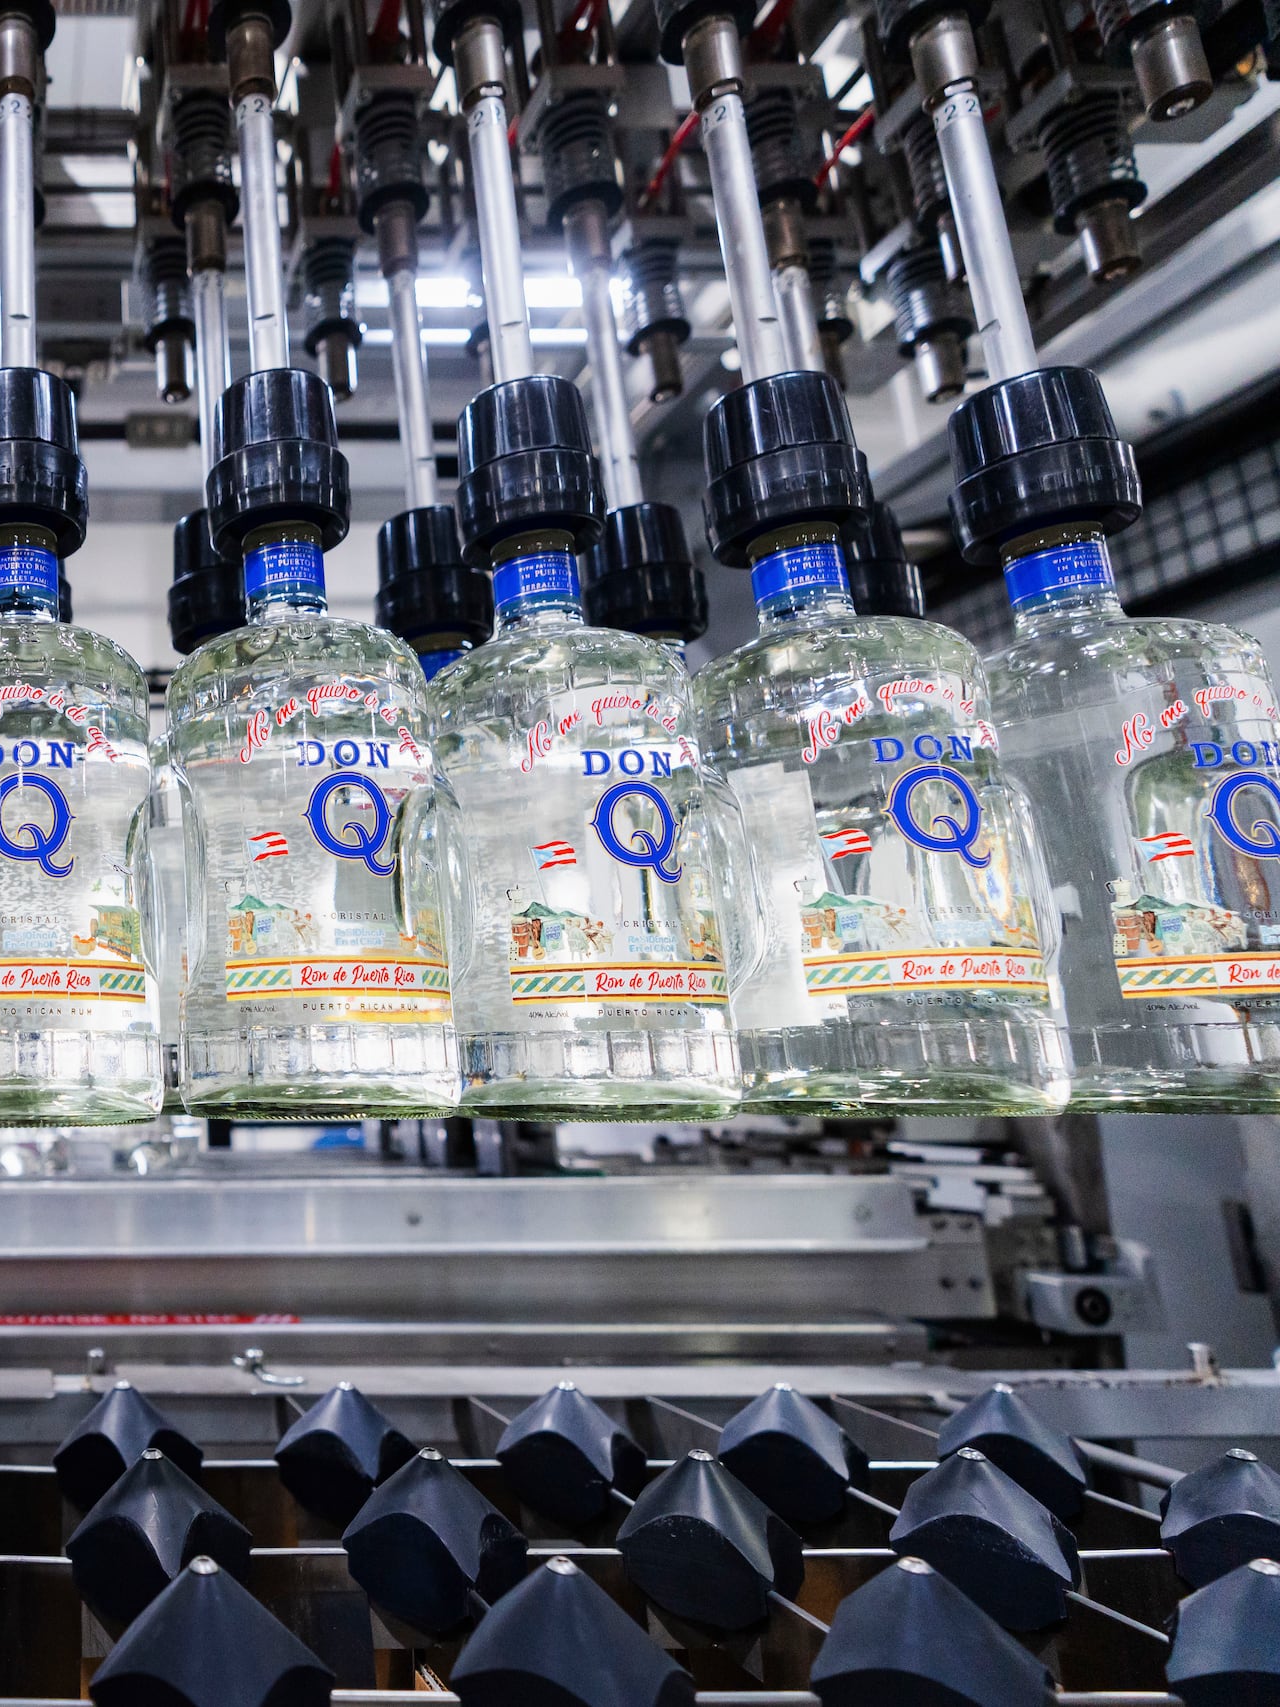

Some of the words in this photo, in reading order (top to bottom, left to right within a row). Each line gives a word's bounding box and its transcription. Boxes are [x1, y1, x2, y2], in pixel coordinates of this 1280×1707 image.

[11, 99, 21, 114] 2
[254, 98, 264, 113] 2
[714, 105, 727, 123] 2
[945, 104, 957, 121] 2
[0, 562, 32, 571] PUERTO
[278, 559, 311, 567] PUERTO
[49, 690, 65, 710] ir
[67, 705, 88, 723] de
[240, 710, 270, 763] No
[275, 698, 298, 725] me
[307, 680, 362, 715] quiero
[364, 690, 379, 711] ir
[380, 705, 399, 724] de
[803, 710, 839, 764] No
[878, 675, 937, 712] quiero
[942, 685, 954, 702] ir
[959, 700, 974, 716] de
[1115, 713, 1154, 766] No
[1161, 700, 1188, 728] me
[1195, 682, 1248, 718] quiero
[1253, 691, 1263, 707] ir
[521, 720, 554, 773] No
[558, 709, 583, 735] me
[592, 691, 644, 726] quiero
[646, 701, 660, 721] ir
[662, 716, 677, 735] de
[296, 740, 390, 768] DON
[872, 735, 974, 763] DON
[581, 750, 672, 778] DON
[301, 770, 396, 877] Q
[880, 763, 992, 869] Q
[588, 780, 682, 884] Q
[1, 916, 60, 924] CRISTAL
[331, 912, 386, 920] CRISTAL
[623, 920, 678, 928] CRISTAL
[1, 970, 15, 985] de
[20, 969, 61, 989] Puerto
[66, 969, 91, 989] Rico
[301, 965, 328, 986] Ron
[333, 967, 346, 983] de
[352, 965, 389, 985] Puerto
[394, 966, 415, 986] Rico
[901, 960, 935, 980] Ron
[939, 960, 955, 975] de
[961, 958, 1001, 978] Puerto
[1006, 958, 1025, 978] Rico
[1228, 964, 1261, 983] Ron
[1267, 964, 1280, 979] de
[595, 972, 625, 992] Ron
[629, 973, 643, 989] de
[648, 972, 684, 992] Puerto
[687, 973, 706, 992] Rico
[303, 1003, 351, 1011] PUERTO
[361, 1003, 393, 1011] RICAN
[906, 997, 961, 1006] PUERTO
[598, 1009, 648, 1017] PUERTO
